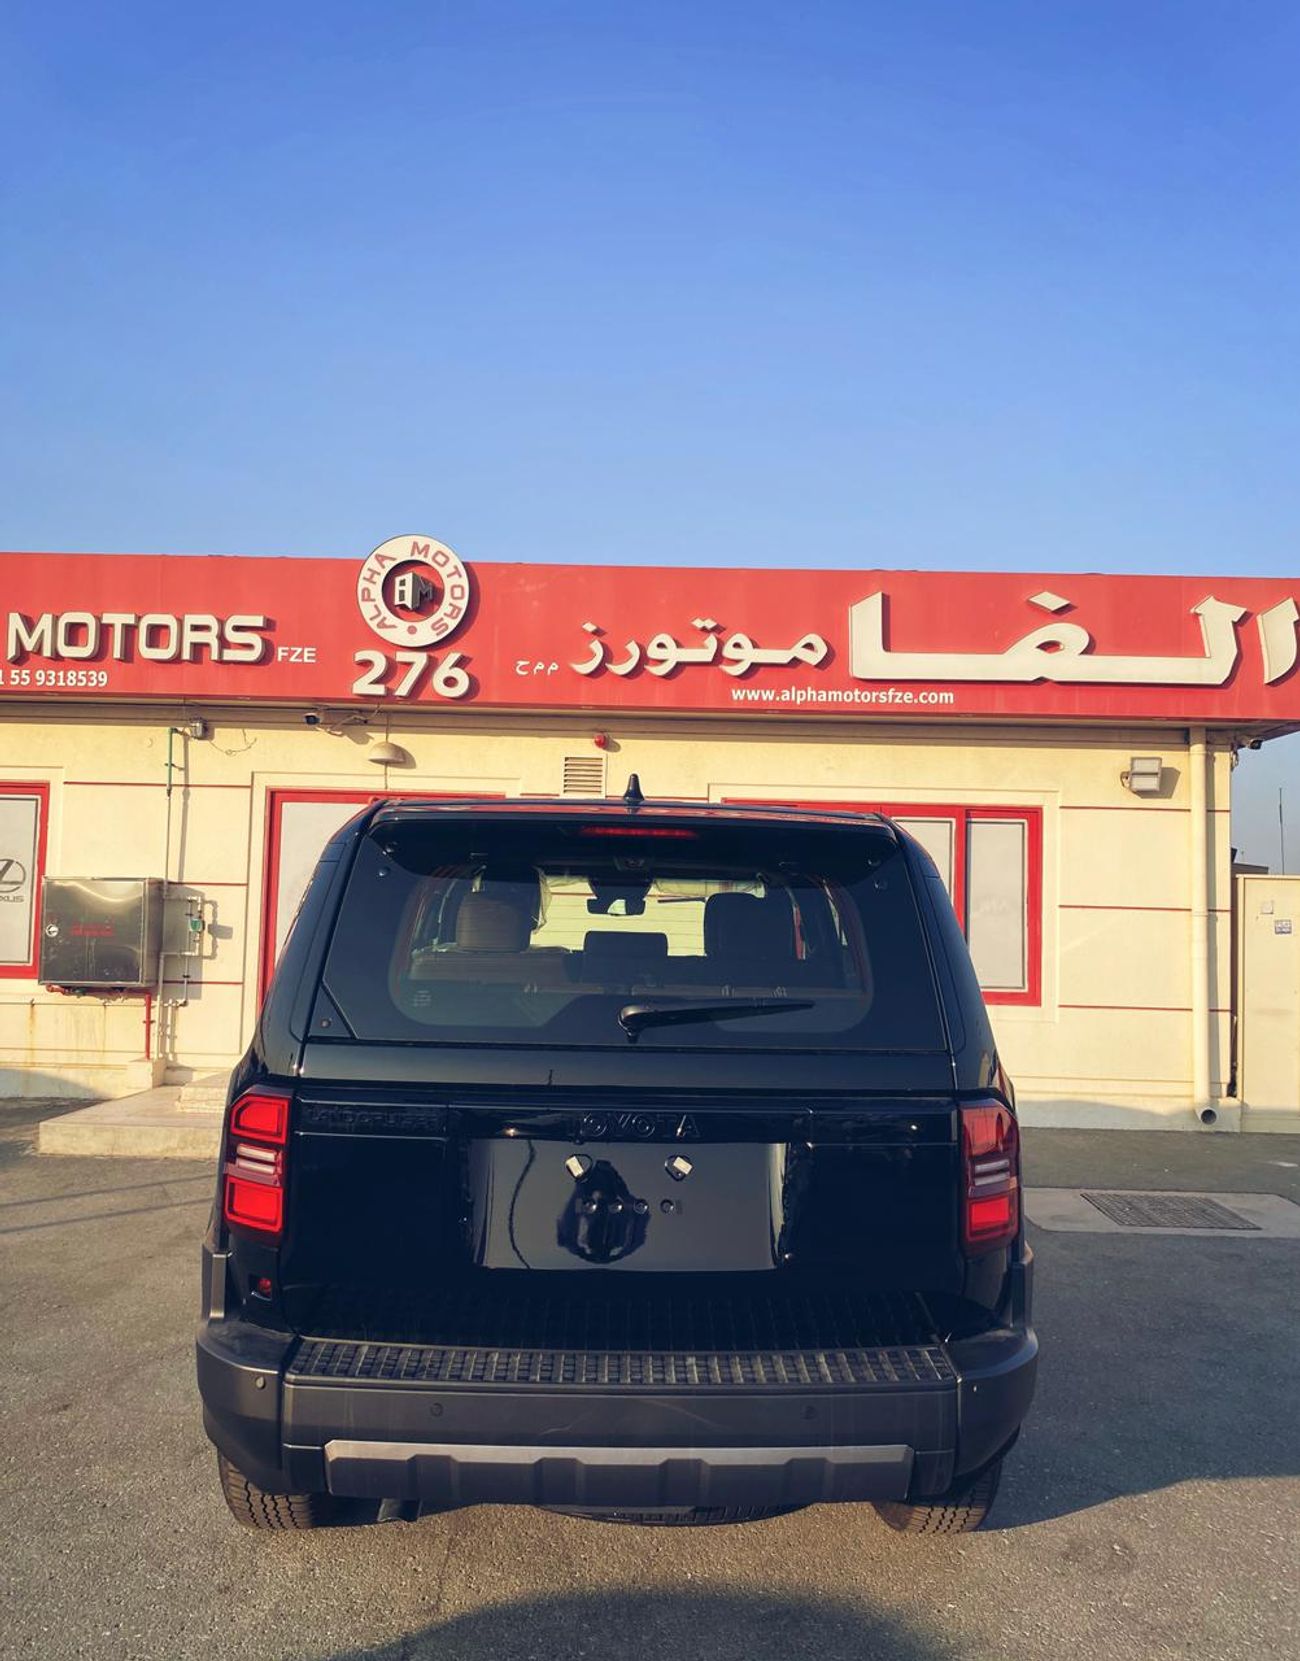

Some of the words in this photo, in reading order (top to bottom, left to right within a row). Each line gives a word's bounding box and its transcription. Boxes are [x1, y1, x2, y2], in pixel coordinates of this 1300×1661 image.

[361, 552, 397, 630] ALPHA
[410, 541, 465, 637] MOTORS
[5, 612, 266, 664] MOTORS
[276, 646, 317, 663] FZE
[568, 617, 829, 677] موتورز
[10, 669, 31, 686] 55
[35, 669, 108, 688] 9318539
[351, 649, 470, 698] 276
[731, 685, 955, 706] www.alphamotorsfze.com
